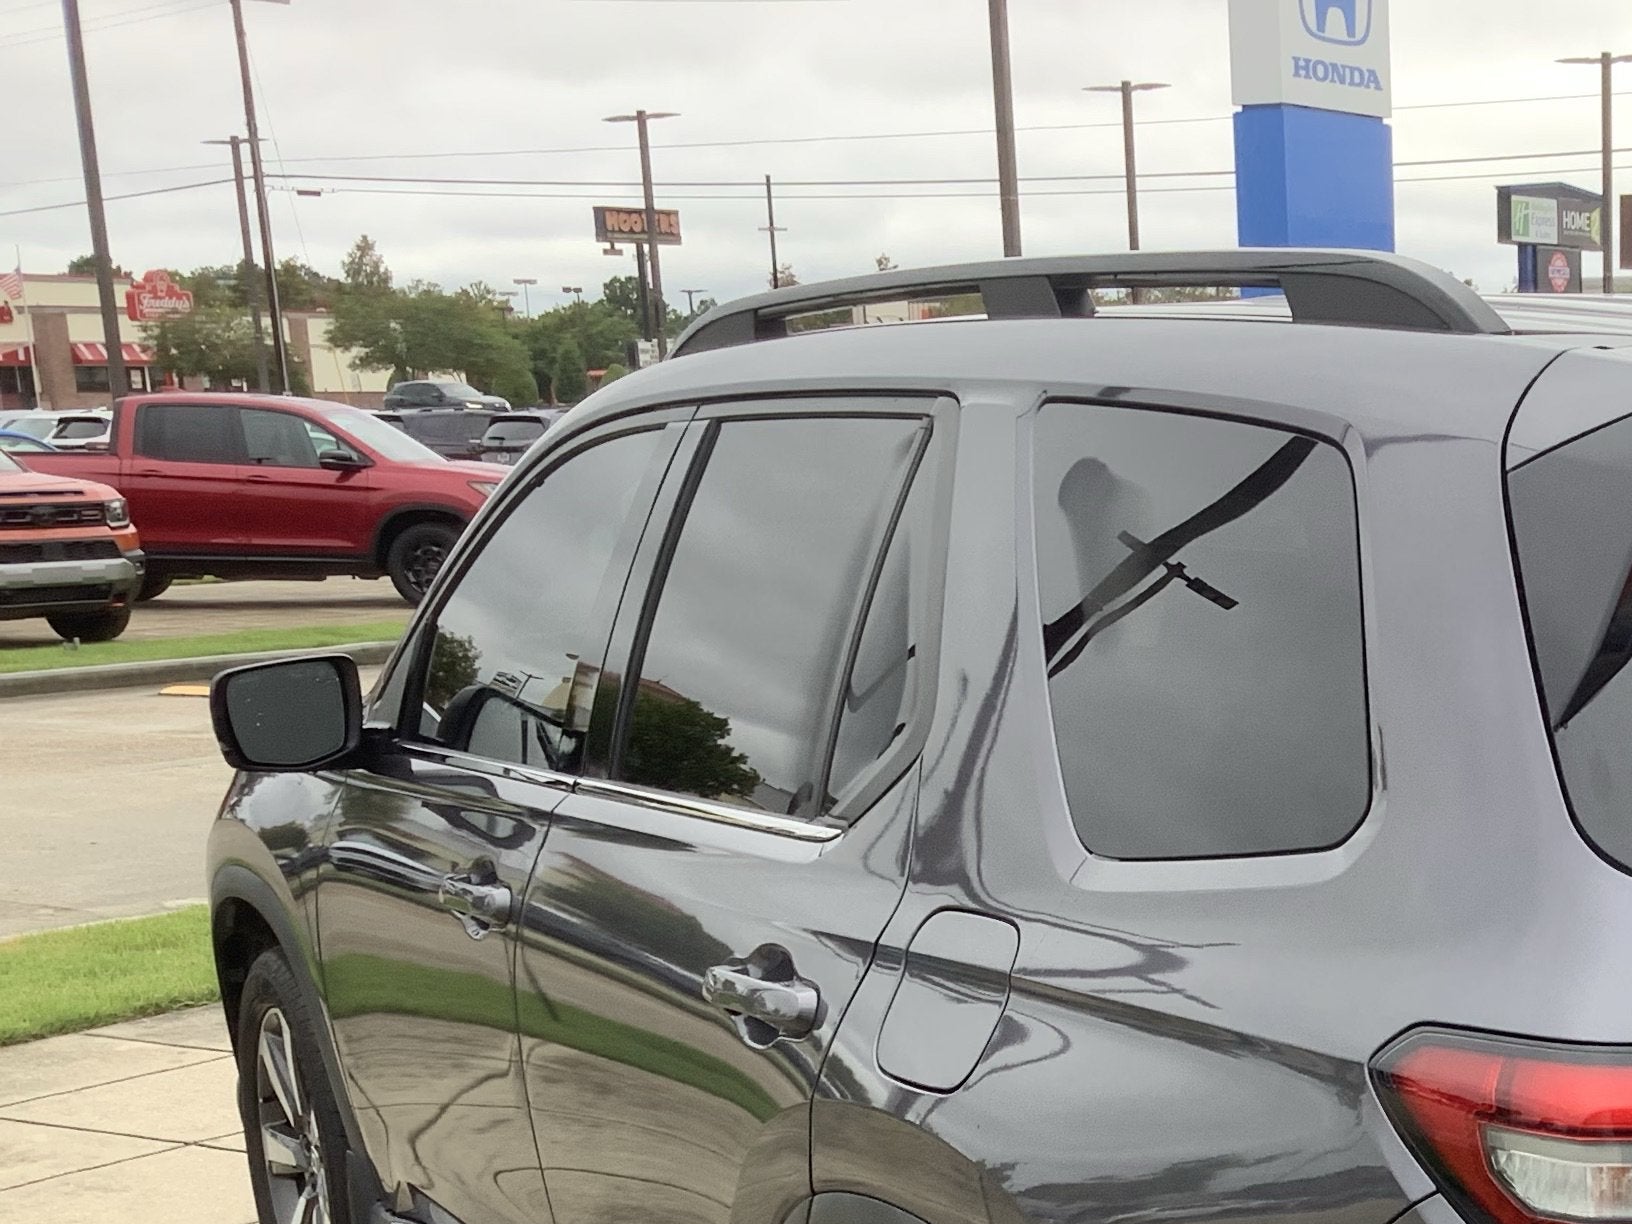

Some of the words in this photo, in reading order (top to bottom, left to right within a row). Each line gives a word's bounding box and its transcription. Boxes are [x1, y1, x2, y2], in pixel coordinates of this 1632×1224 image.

[1291, 55, 1384, 92] HONDA
[604, 209, 680, 235] HOORS
[1562, 209, 1591, 231] HOME
[140, 293, 190, 312] Freddy's
